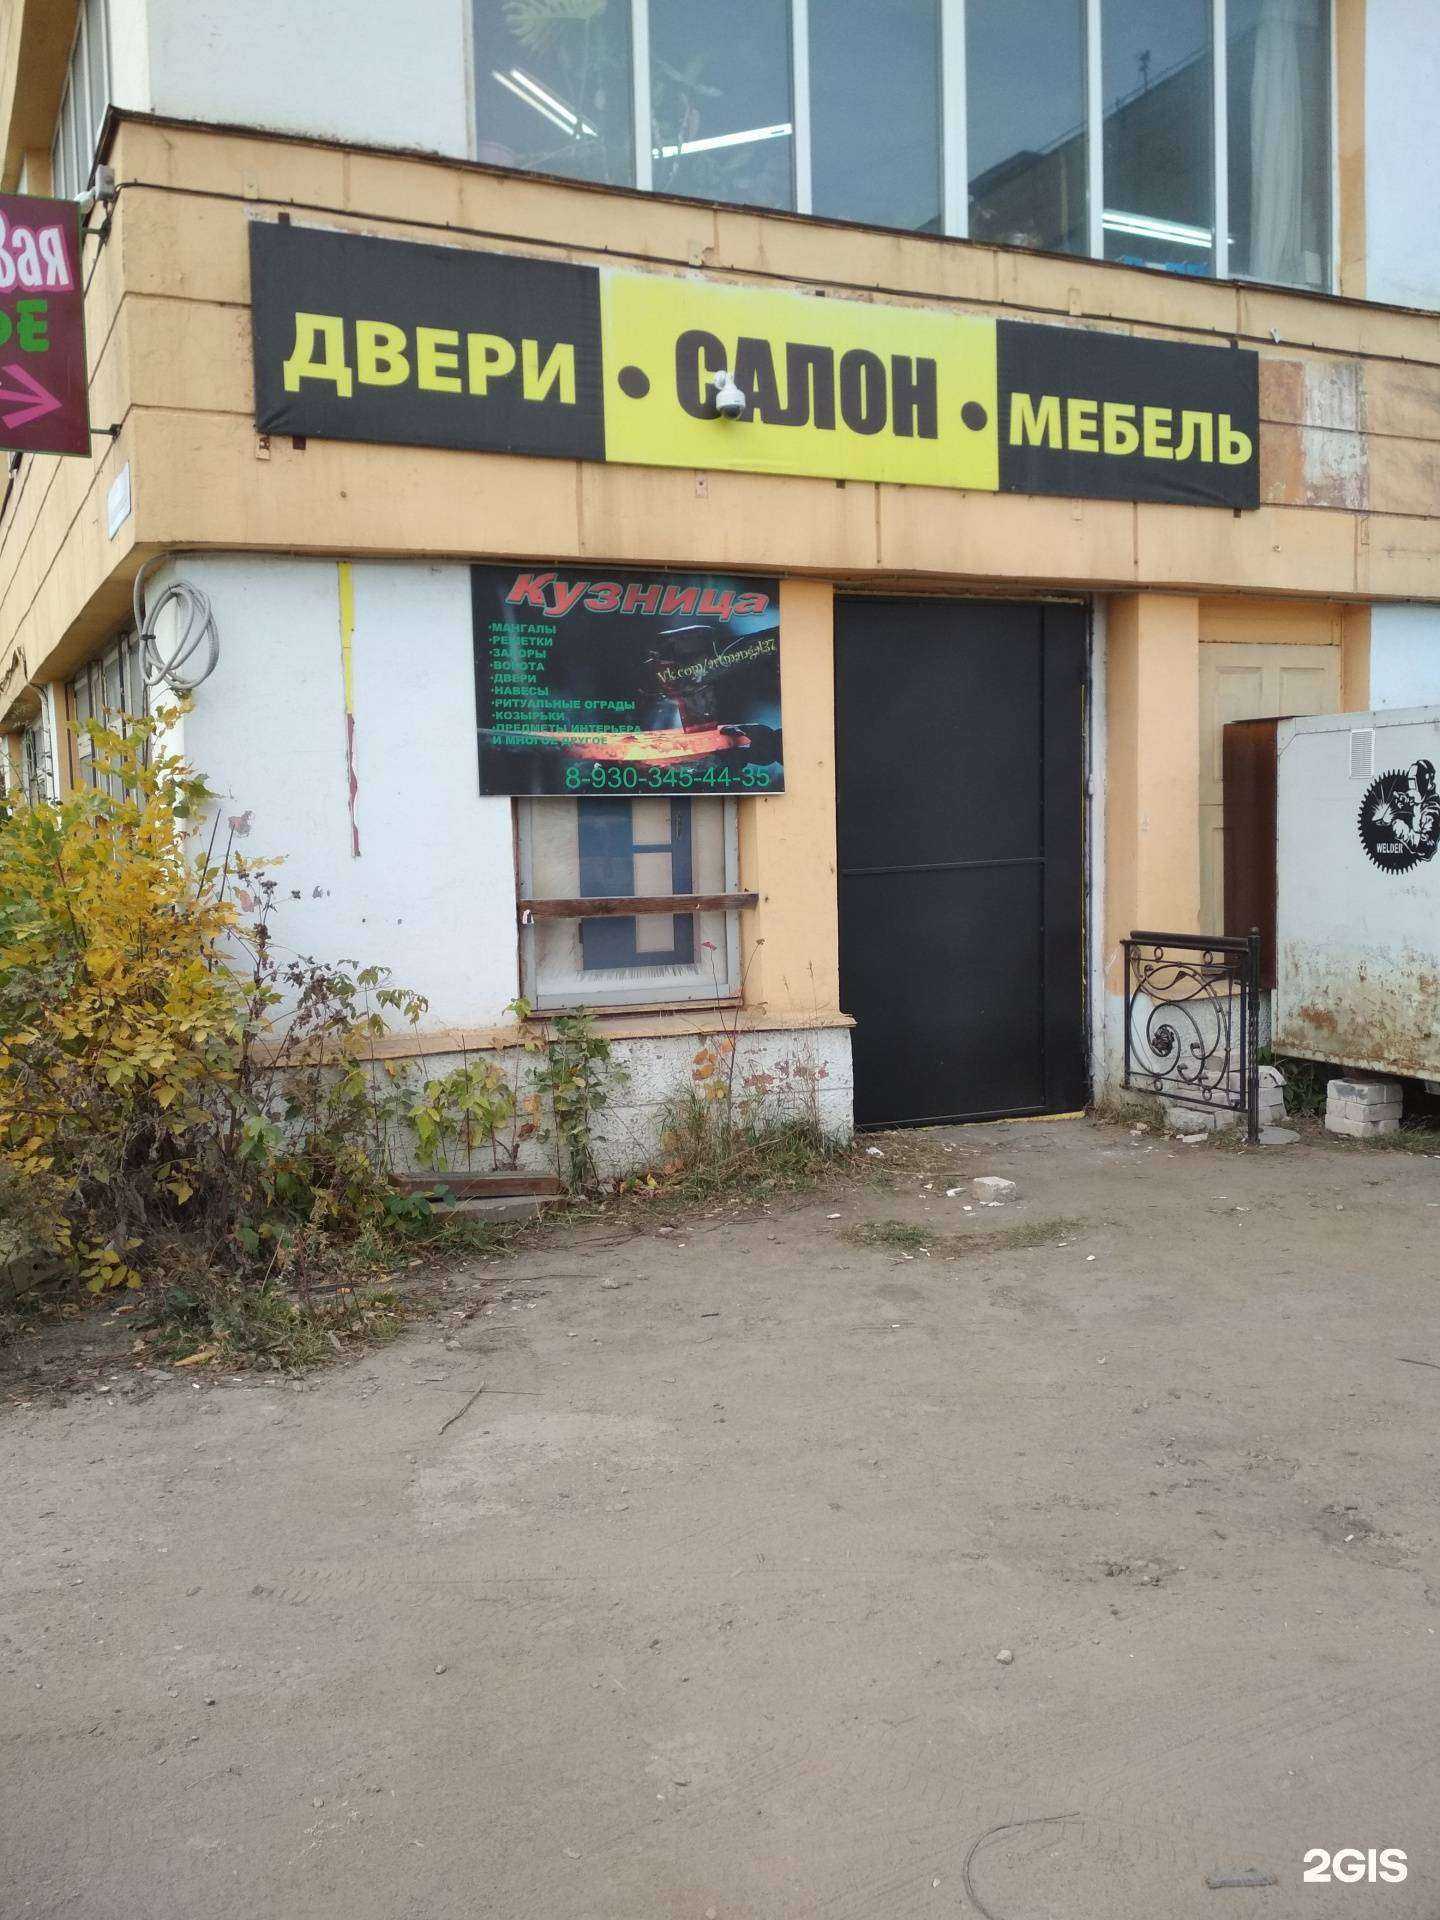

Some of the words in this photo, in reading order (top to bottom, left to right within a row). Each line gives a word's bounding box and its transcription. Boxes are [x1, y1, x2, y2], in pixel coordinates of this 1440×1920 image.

[283, 312, 577, 405] ДВЕРИ
[675, 329, 938, 440] САЛОН
[1009, 392, 1253, 466] МЕБЕЛЬ
[505, 572, 770, 622] Кузница
[584, 700, 636, 712] ОГРАДЫ
[564, 766, 770, 789] 8-930-345-44-35
[1376, 842, 1404, 854] WELDER
